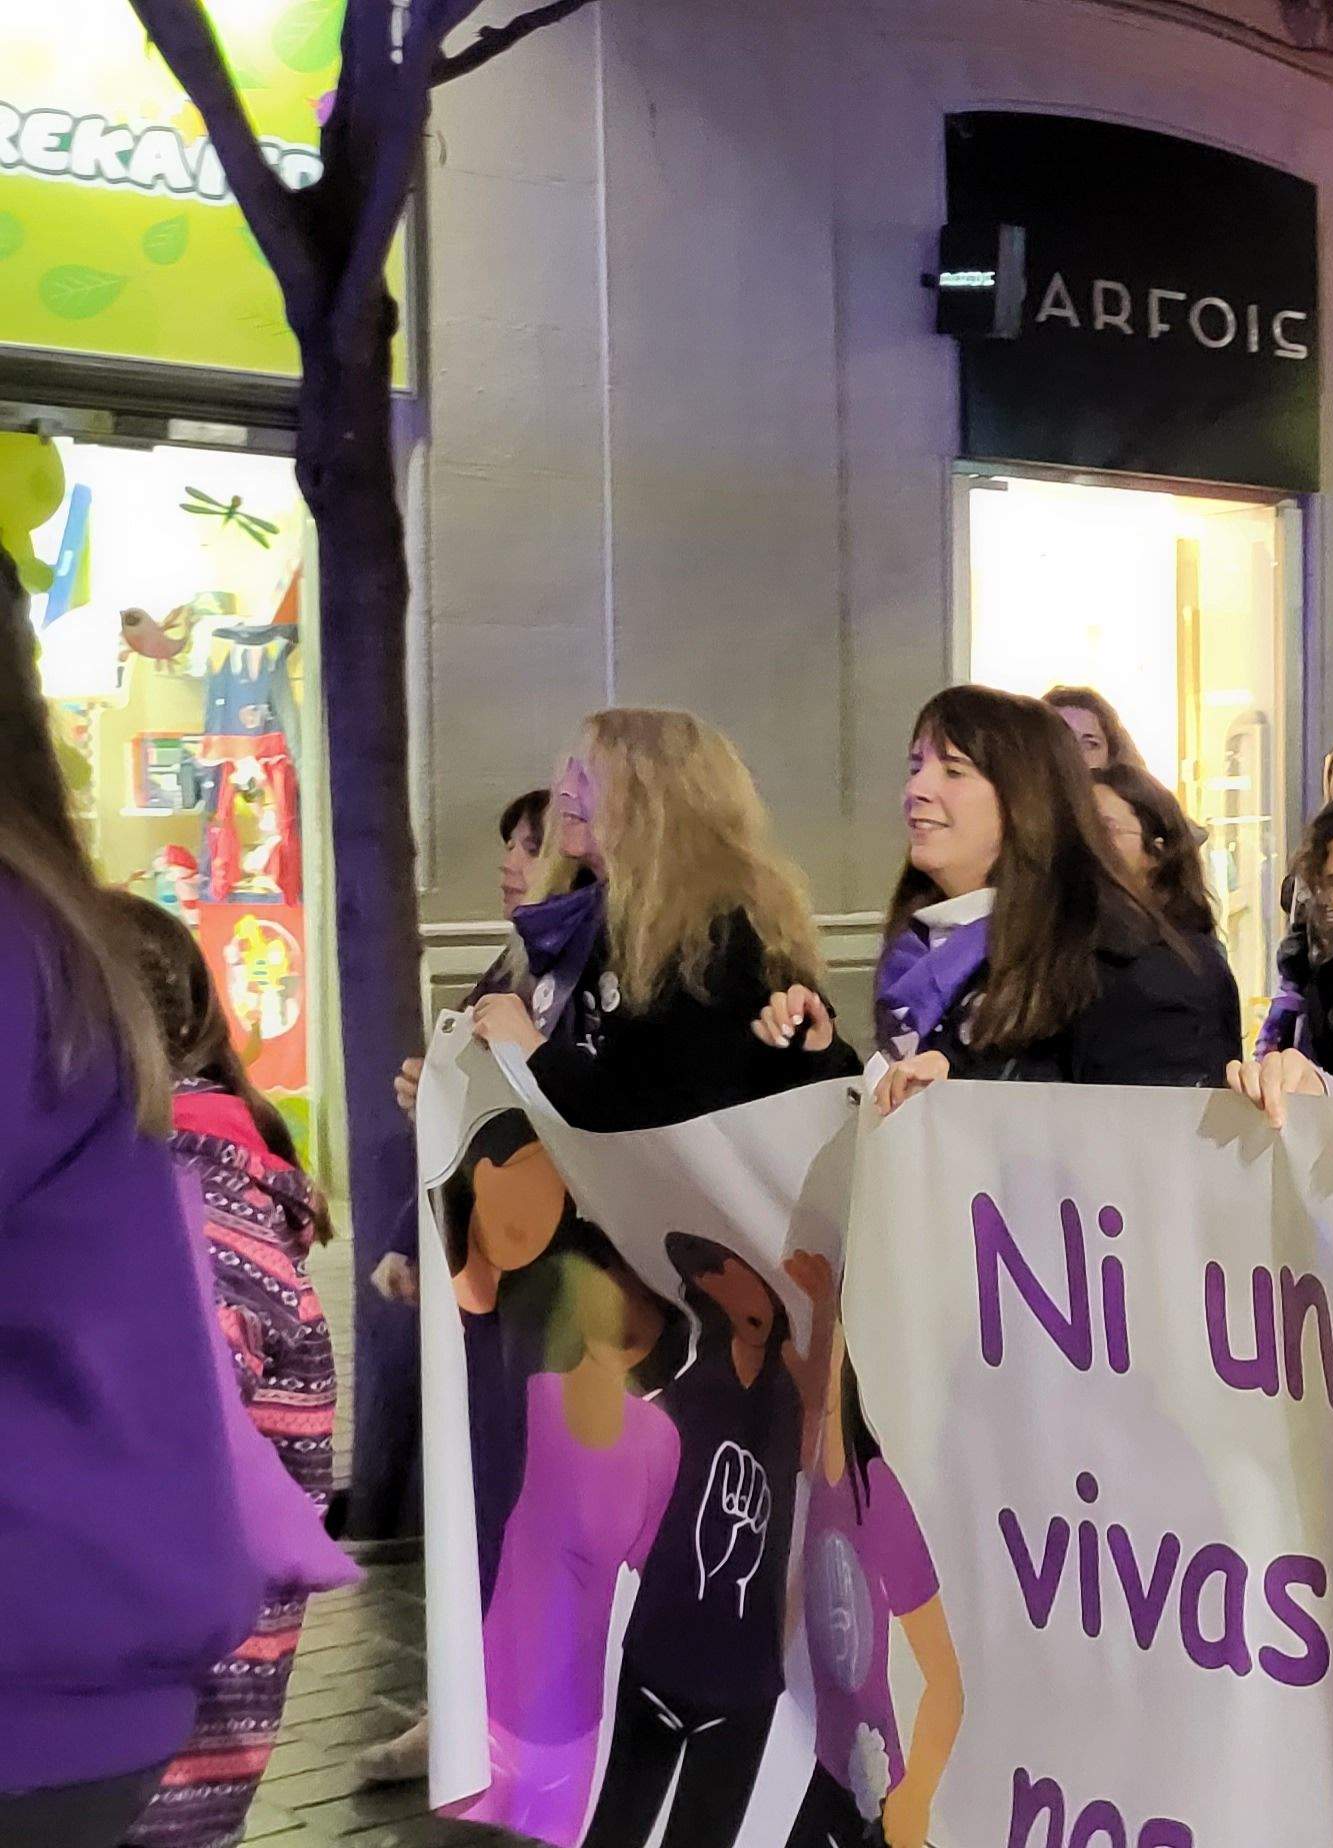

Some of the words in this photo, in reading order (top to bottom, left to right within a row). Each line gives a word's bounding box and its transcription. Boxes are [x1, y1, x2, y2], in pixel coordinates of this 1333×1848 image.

[1035, 271, 1307, 360] ARFOIS
[971, 1191, 1131, 1375] Ni
[998, 1470, 1330, 1687] vivas
